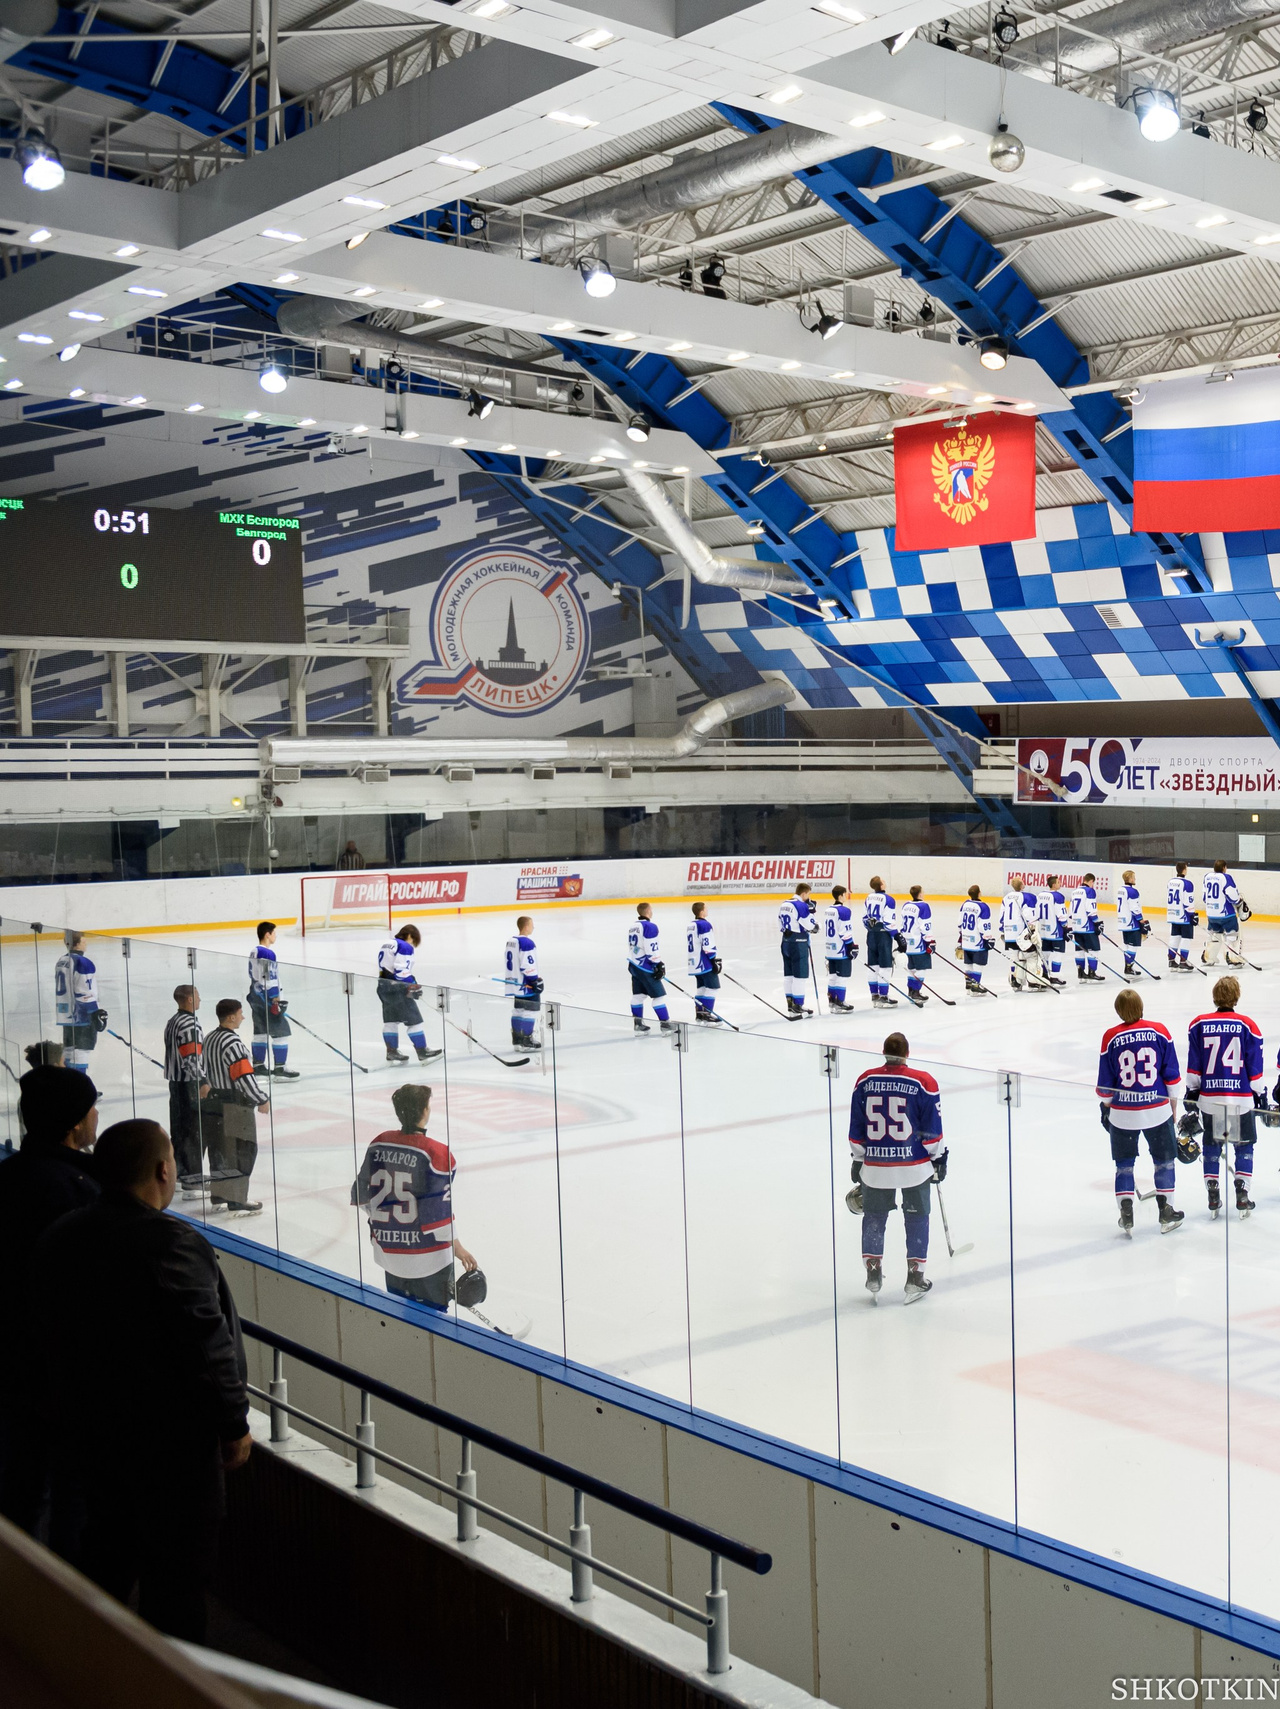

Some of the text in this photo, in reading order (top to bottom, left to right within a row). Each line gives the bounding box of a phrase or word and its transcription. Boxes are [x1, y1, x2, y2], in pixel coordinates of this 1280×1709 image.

[94, 509, 150, 534] 0:51
[220, 513, 244, 525] МХК
[252, 539, 272, 566] 0
[120, 563, 139, 589] 0
[445, 561, 576, 662] МОЛОДЕЖНАЯ ХОККЕЙНАЯ КОМАНДА
[470, 677, 554, 704] ЛИПЕЦК
[1060, 738, 1161, 803] 50 ЛЕТ
[1169, 757, 1263, 767] ДВОРЦУ СПОРТА
[520, 866, 557, 876] КРАСНАЯ
[687, 860, 835, 882] REDMACHINE.RU
[519, 877, 558, 889] МАШИНА
[1207, 882, 1219, 899] 20
[1008, 902, 1013, 920] 1
[903, 915, 915, 933] 37
[962, 912, 976, 931] 99
[527, 955, 535, 965] 8
[1202, 1024, 1243, 1034] ИВАНОВ
[1203, 1036, 1244, 1075] 74
[1118, 1047, 1158, 1088] 83
[1205, 1079, 1241, 1091] ЛИПЕЦК
[1118, 1089, 1159, 1104] ЛИПЕЦК
[865, 1096, 913, 1141] 55
[373, 1149, 418, 1168] ЗАХАРОВ
[866, 1145, 914, 1159] ЛИПЕЦК
[369, 1168, 419, 1224] 25
[372, 1228, 421, 1246] ИПЕЦК
